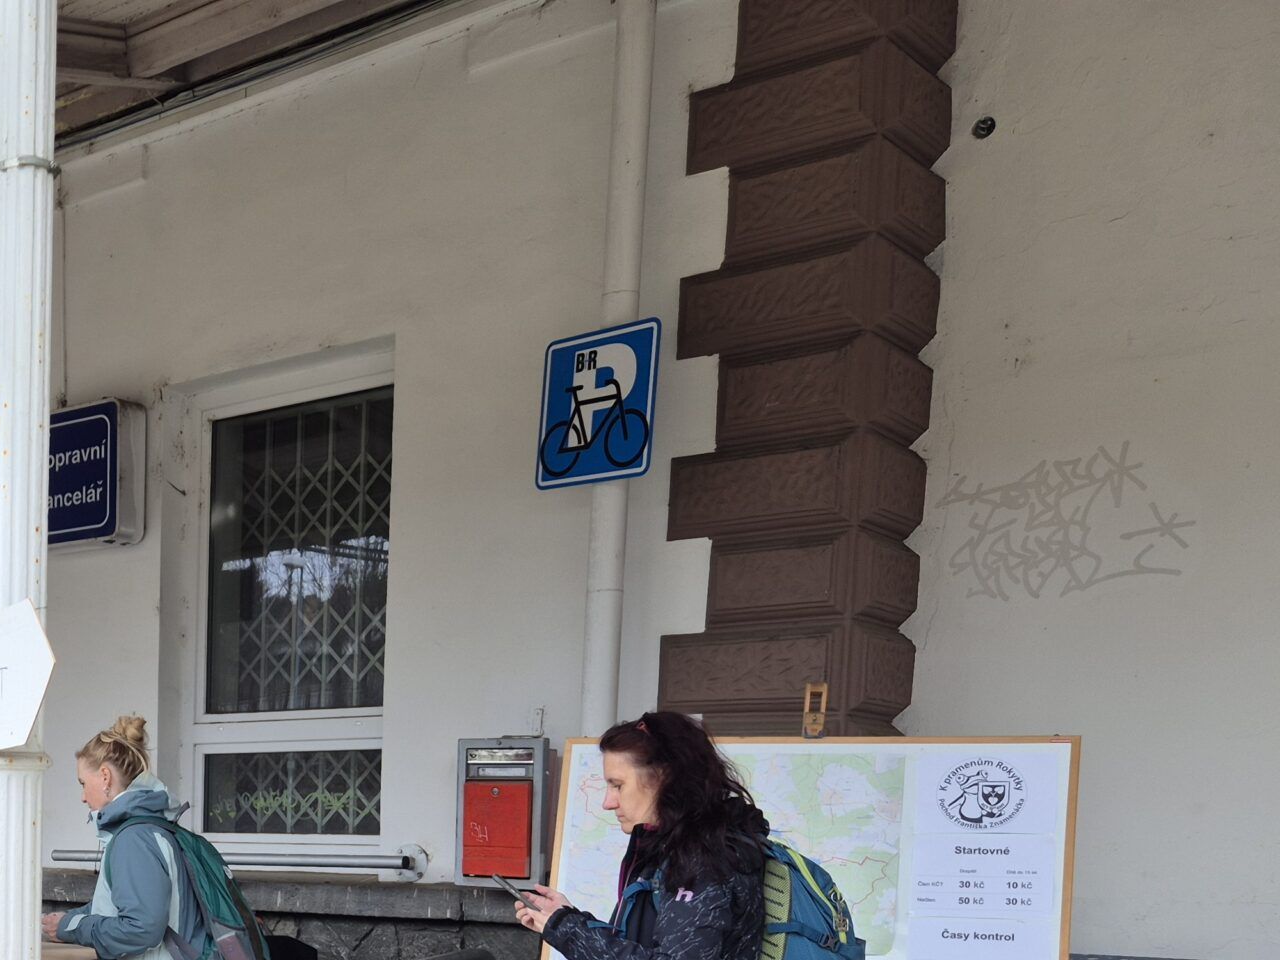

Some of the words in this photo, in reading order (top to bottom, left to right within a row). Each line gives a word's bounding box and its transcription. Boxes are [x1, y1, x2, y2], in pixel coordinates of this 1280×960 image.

[48, 438, 107, 472] opravní
[48, 480, 104, 510] ancelář
[939, 784, 948, 792] K
[944, 757, 994, 785] pramenům
[995, 760, 1024, 792] Rokytky
[939, 798, 957, 820] Pochod
[954, 845, 1011, 856] Startovné
[958, 881, 971, 889] 30
[973, 881, 985, 889] kč
[1006, 881, 1018, 889] 10
[1021, 881, 1033, 889] kč
[958, 897, 970, 905] 50
[972, 897, 984, 905] kč
[1005, 897, 1018, 906] 30
[1020, 897, 1032, 906] kč
[941, 929, 970, 941] Časy
[973, 931, 1015, 942] kontrol
